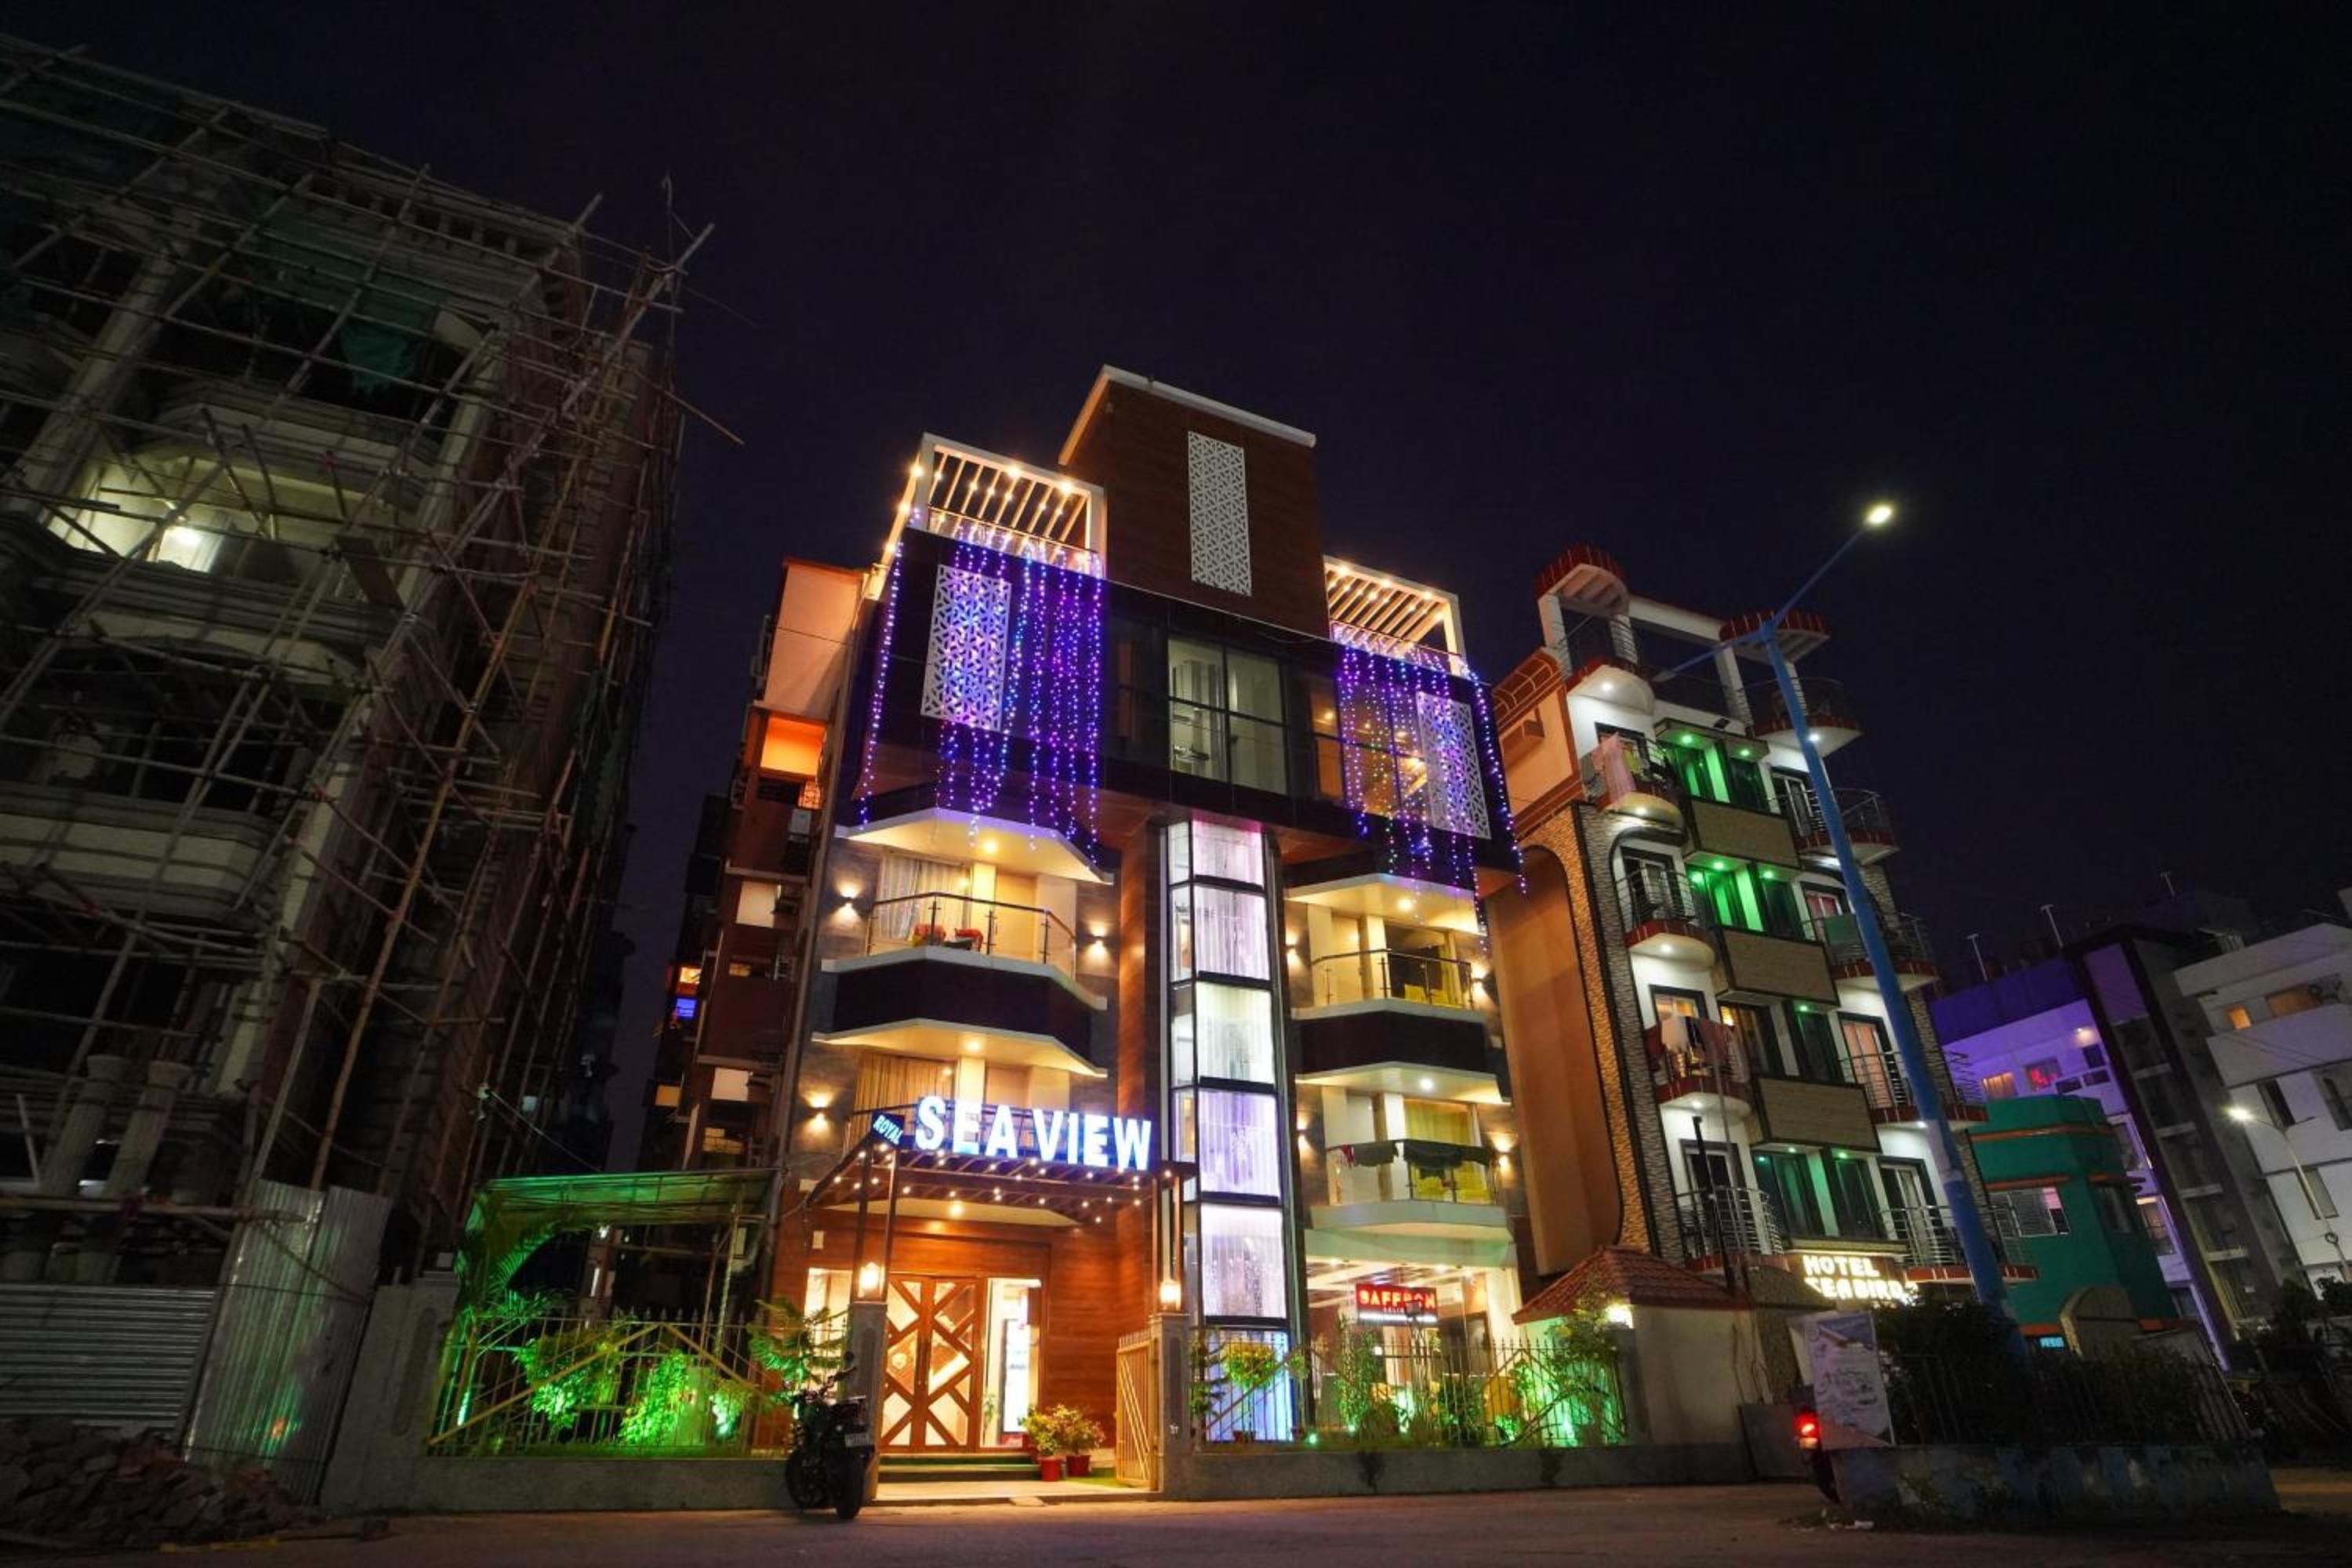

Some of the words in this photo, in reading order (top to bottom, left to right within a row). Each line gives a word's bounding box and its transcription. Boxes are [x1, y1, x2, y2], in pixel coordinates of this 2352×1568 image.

[873, 1114, 903, 1145] ROYAL
[915, 1095, 1018, 1158] SEA
[1033, 1109, 1152, 1171] VIEW
[1802, 1254, 1880, 1277] HOTEL
